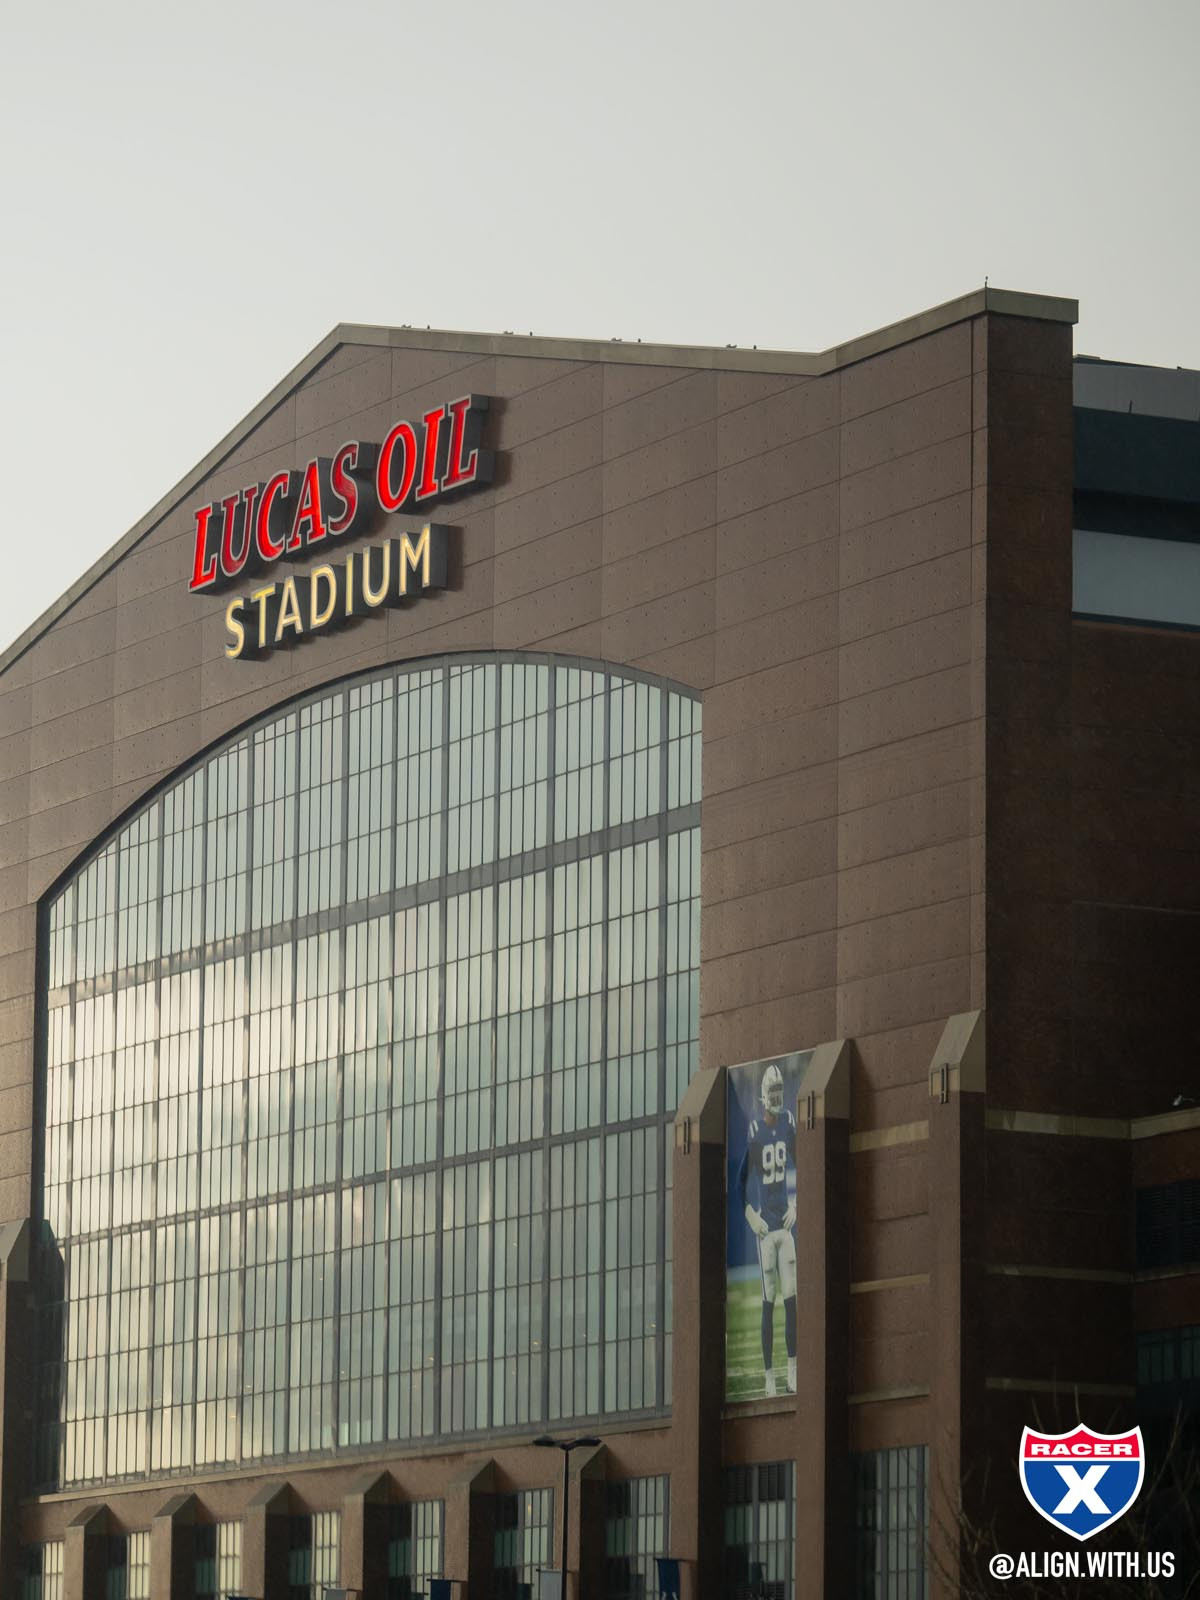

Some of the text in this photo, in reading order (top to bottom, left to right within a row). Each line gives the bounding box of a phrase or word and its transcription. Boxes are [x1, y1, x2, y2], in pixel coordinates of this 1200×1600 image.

[188, 393, 479, 593] LUCAS OIL
[224, 522, 432, 660] STADIUM
[762, 1141, 787, 1185] 99
